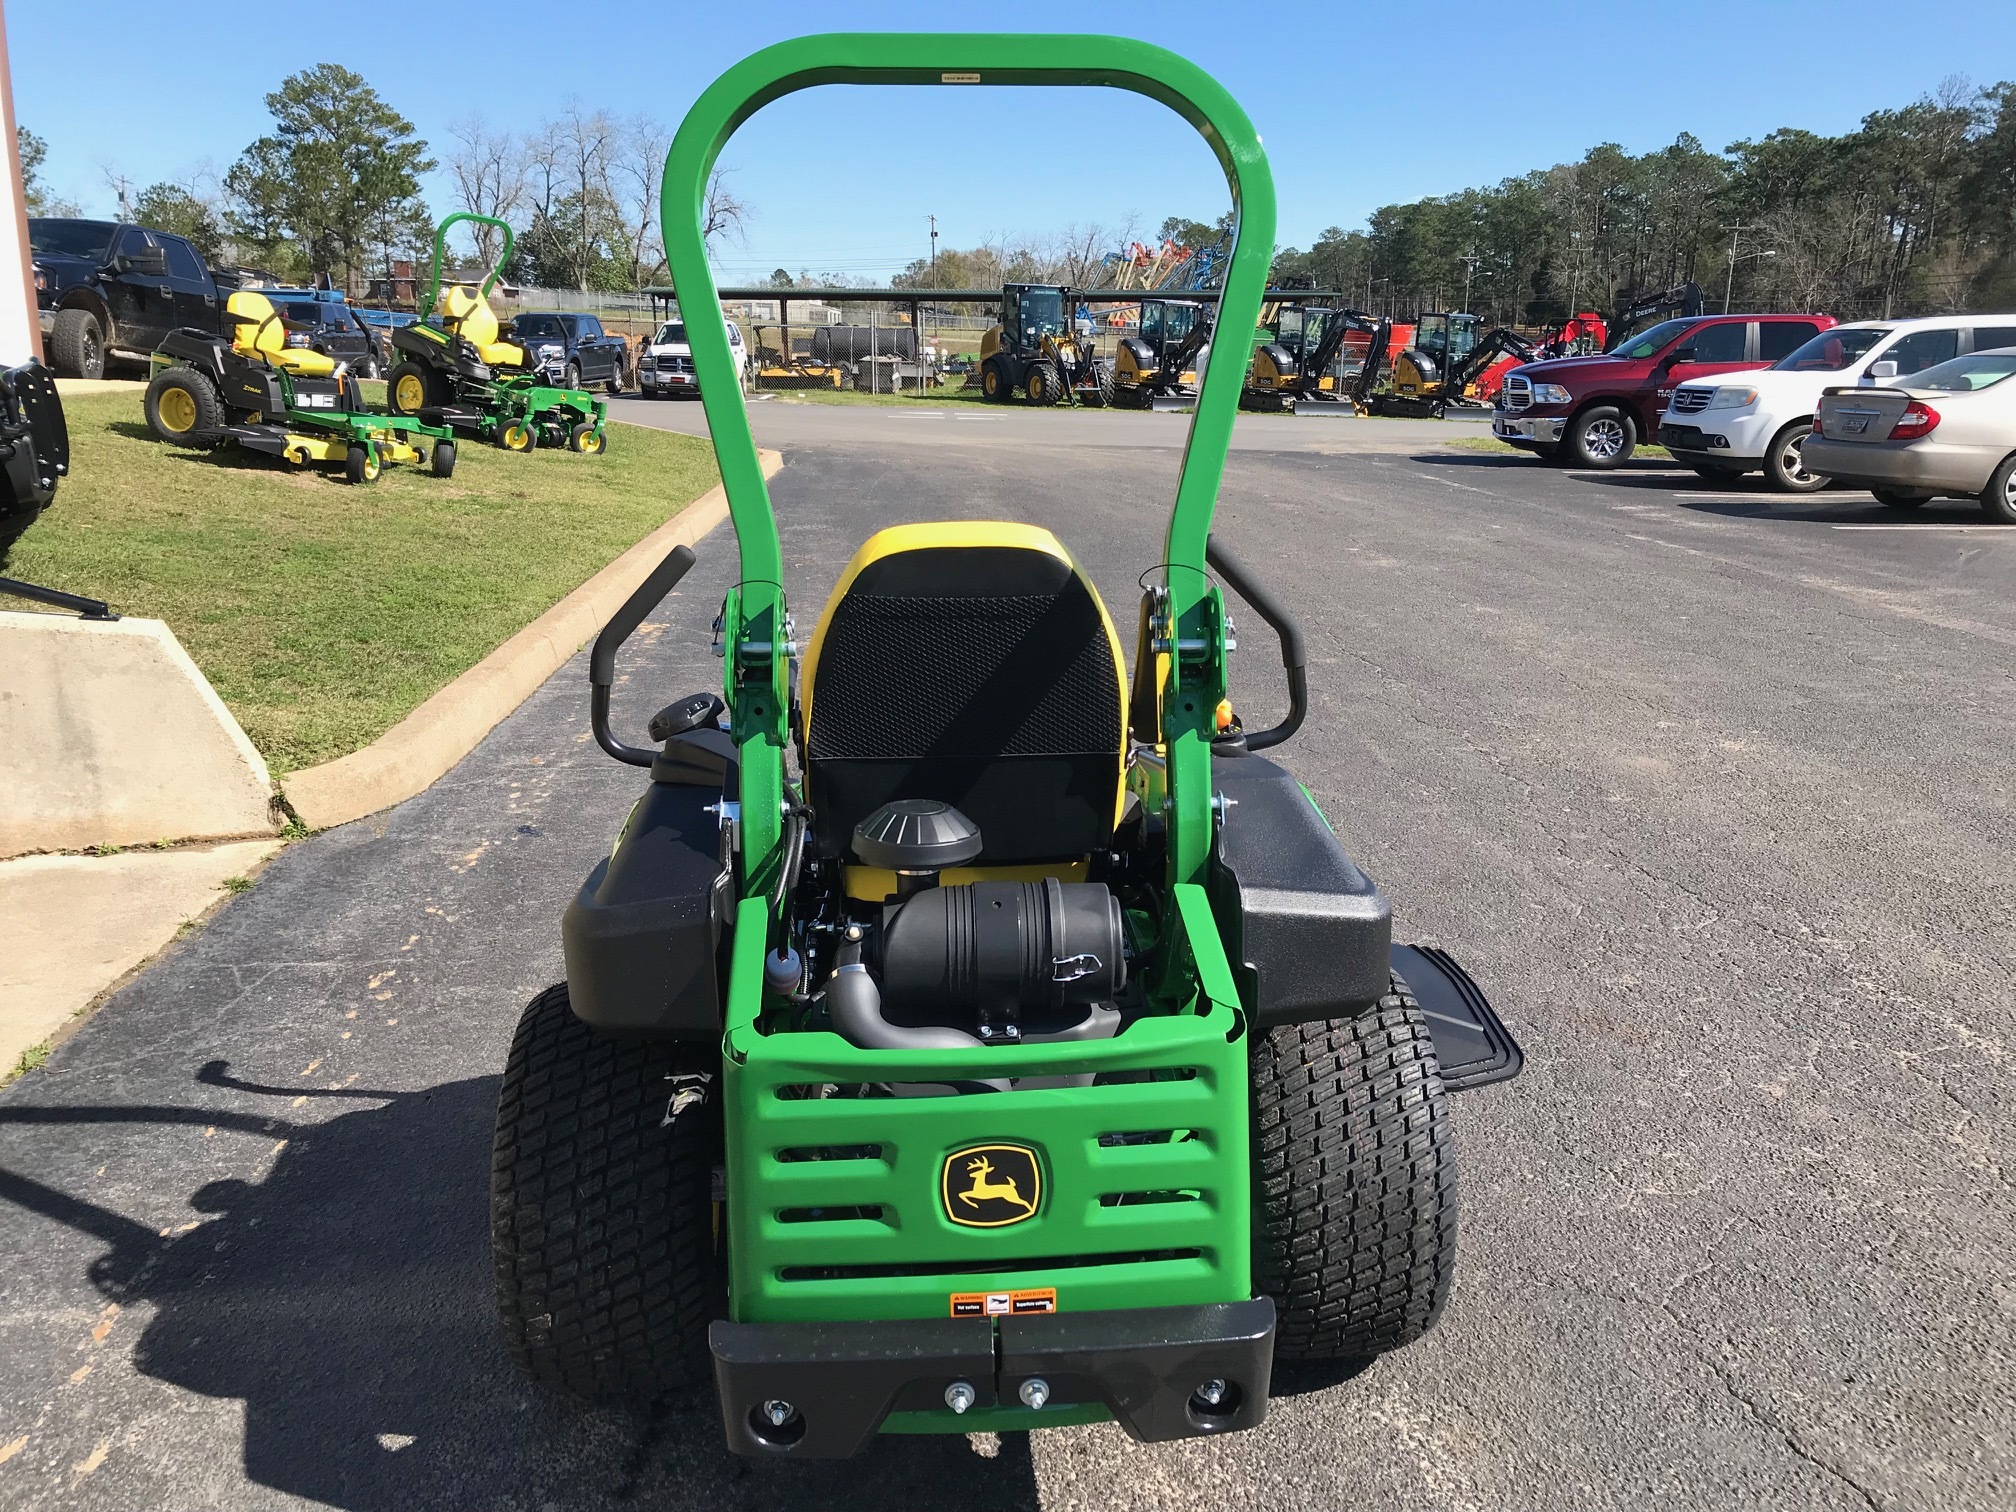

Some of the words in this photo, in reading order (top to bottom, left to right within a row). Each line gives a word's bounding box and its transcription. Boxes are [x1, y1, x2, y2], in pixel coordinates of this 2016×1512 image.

[1636, 307, 1657, 317] DEERE
[1346, 320, 1359, 329] DEERE
[1503, 342, 1519, 356] DEERE
[499, 373, 514, 381] JOHN
